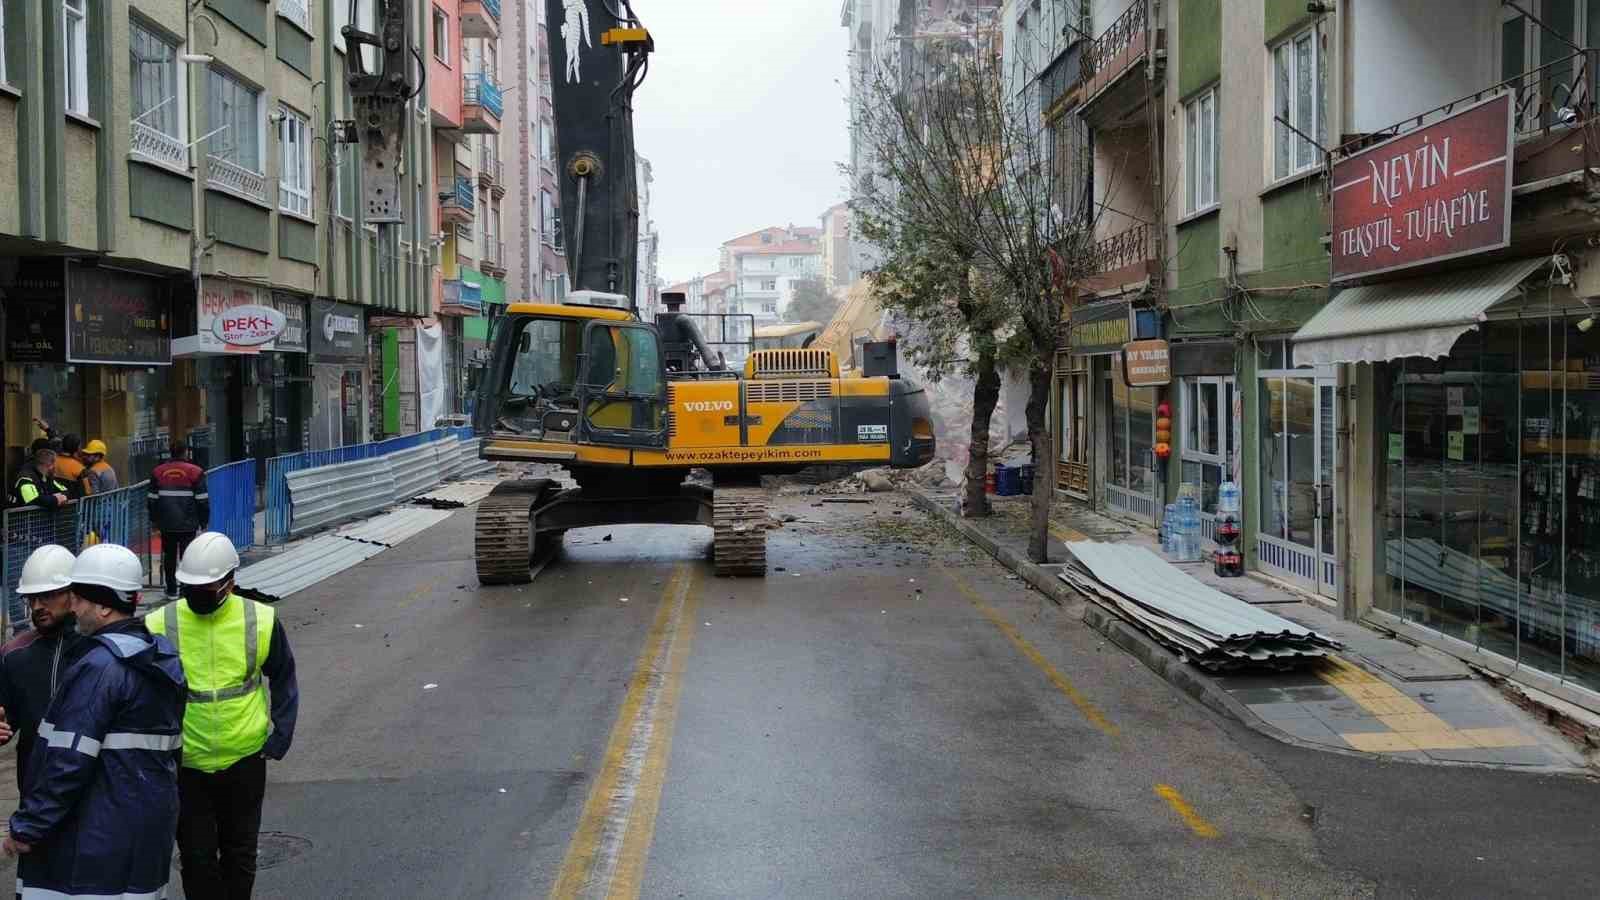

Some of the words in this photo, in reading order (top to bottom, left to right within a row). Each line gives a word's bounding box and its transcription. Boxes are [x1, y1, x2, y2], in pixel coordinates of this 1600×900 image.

[1368, 135, 1450, 208] NEVİN
[684, 400, 733, 412] VOLVO
[664, 449, 822, 462] www.ozaktepeyikim.com
